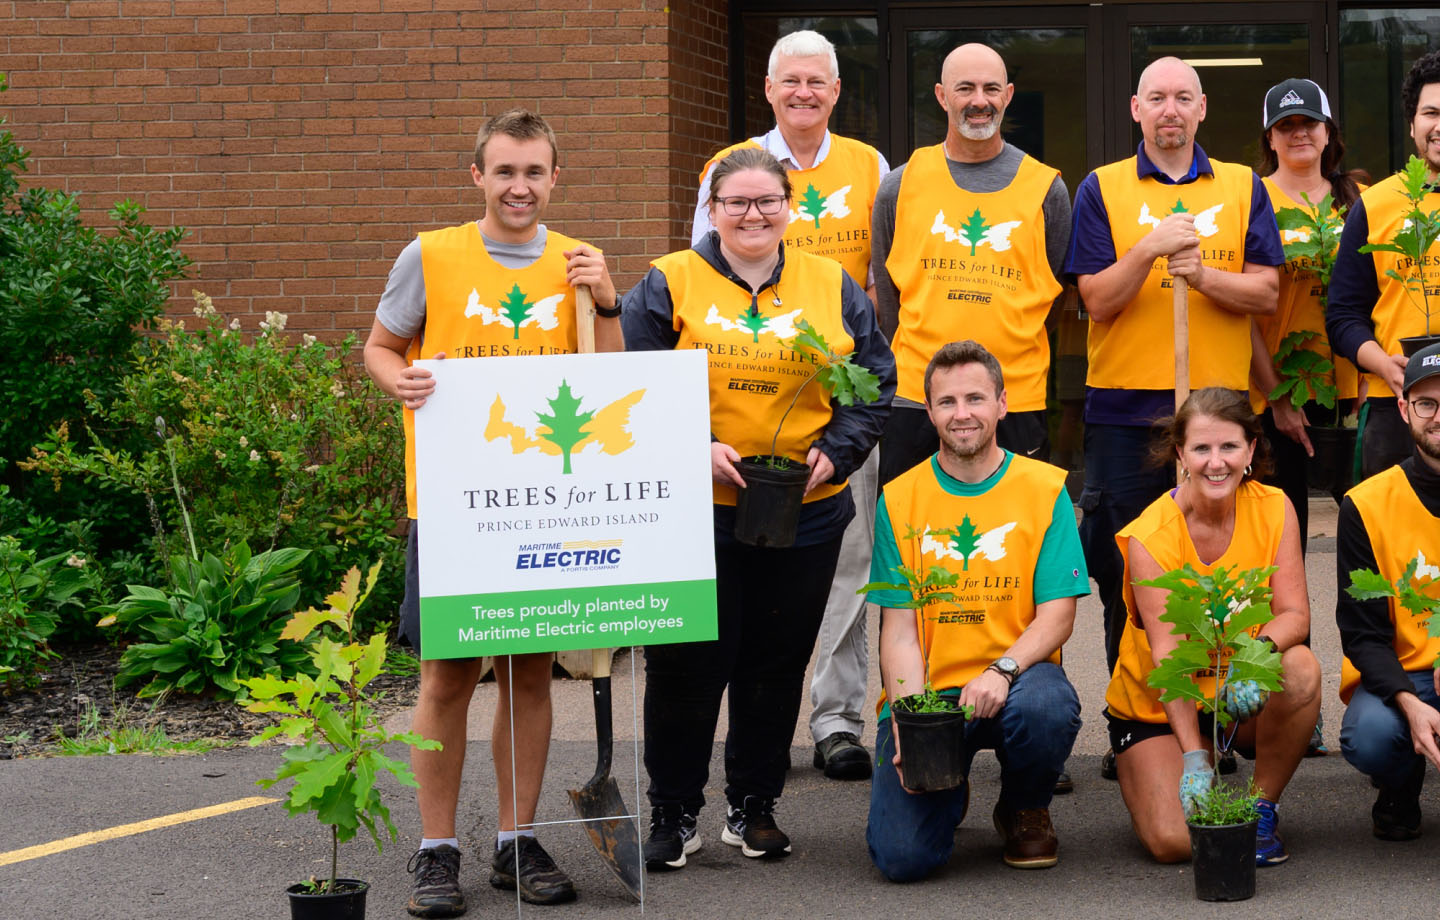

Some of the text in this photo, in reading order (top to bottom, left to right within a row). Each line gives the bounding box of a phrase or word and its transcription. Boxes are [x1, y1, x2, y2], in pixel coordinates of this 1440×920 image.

[786, 229, 869, 248] EES for LIFE
[1202, 249, 1235, 261] LIFE
[920, 258, 1022, 281] TREES for LIFE
[947, 292, 991, 303] ELECTRIC
[455, 344, 510, 359] TREES
[753, 348, 773, 360] for
[709, 361, 810, 378] INCE EDWARD ISLAND
[728, 382, 779, 394] ELECTRIC
[464, 480, 671, 509] TREES for LIFE
[477, 512, 660, 533] PRINCE EDWARD ISLAND
[518, 542, 562, 551] MARITIME
[515, 548, 621, 569] ELECTRIC
[961, 577, 980, 591] for
[983, 576, 1020, 588] LIFE
[471, 594, 669, 621] Trees proudly planted by
[938, 614, 985, 624] ELECTRIC
[458, 616, 684, 642] Maritime Electric employees
